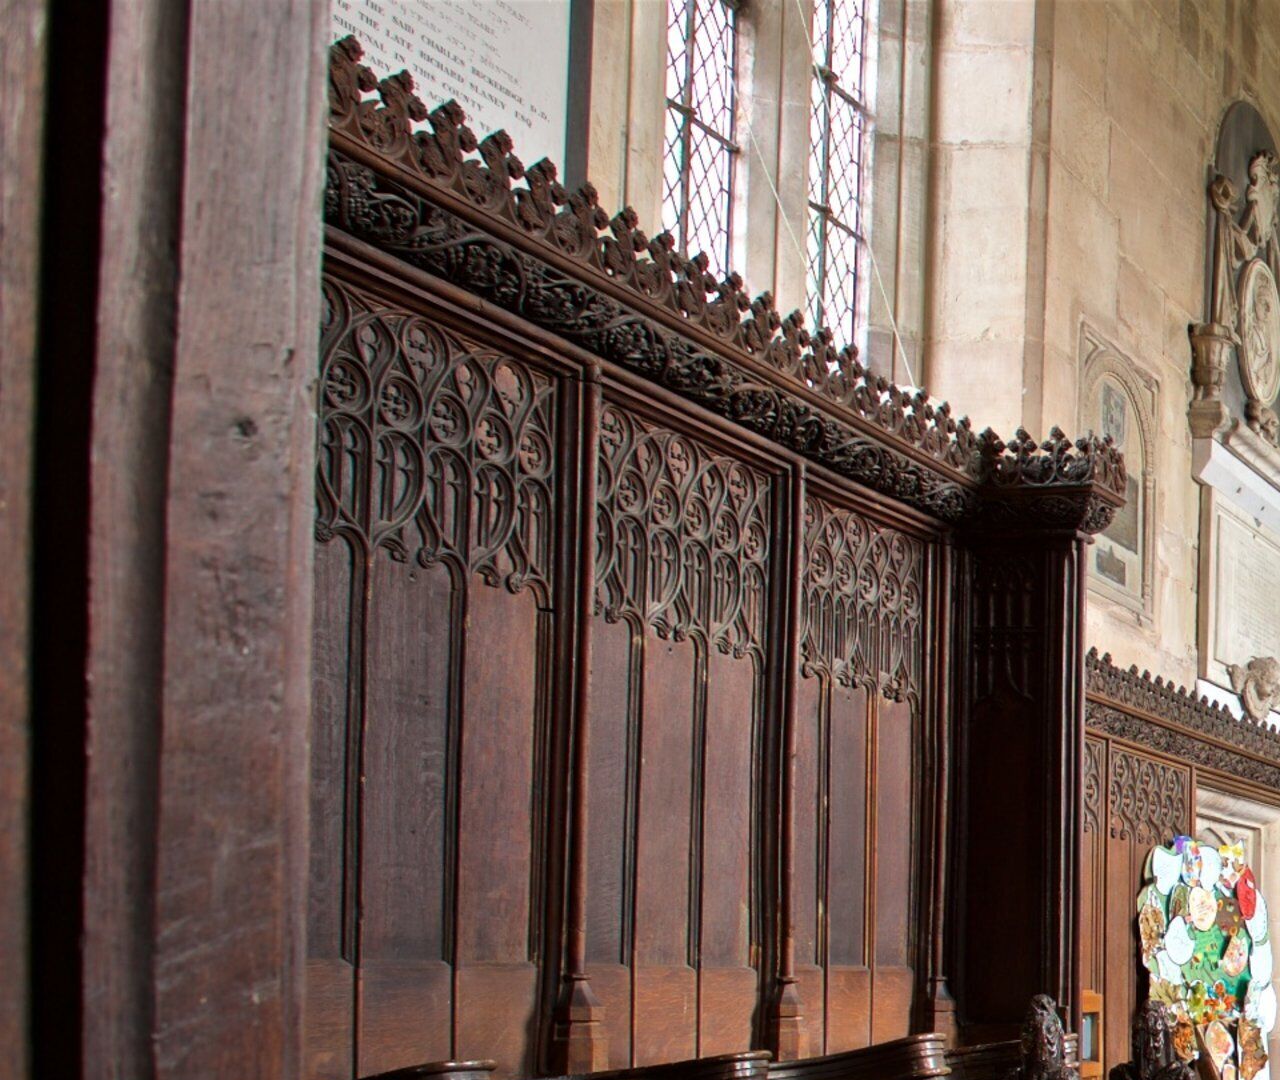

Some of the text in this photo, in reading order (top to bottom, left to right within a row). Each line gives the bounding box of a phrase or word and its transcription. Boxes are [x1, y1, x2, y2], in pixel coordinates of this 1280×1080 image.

[358, 10, 379, 32] THE
[385, 27, 413, 52] LATE
[419, 49, 463, 84] RICHARD
[392, 14, 414, 35] SAID
[420, 33, 464, 68] CHARLES
[394, 50, 405, 65] IN
[412, 62, 435, 83] THIS
[442, 81, 483, 113] COUNTY
